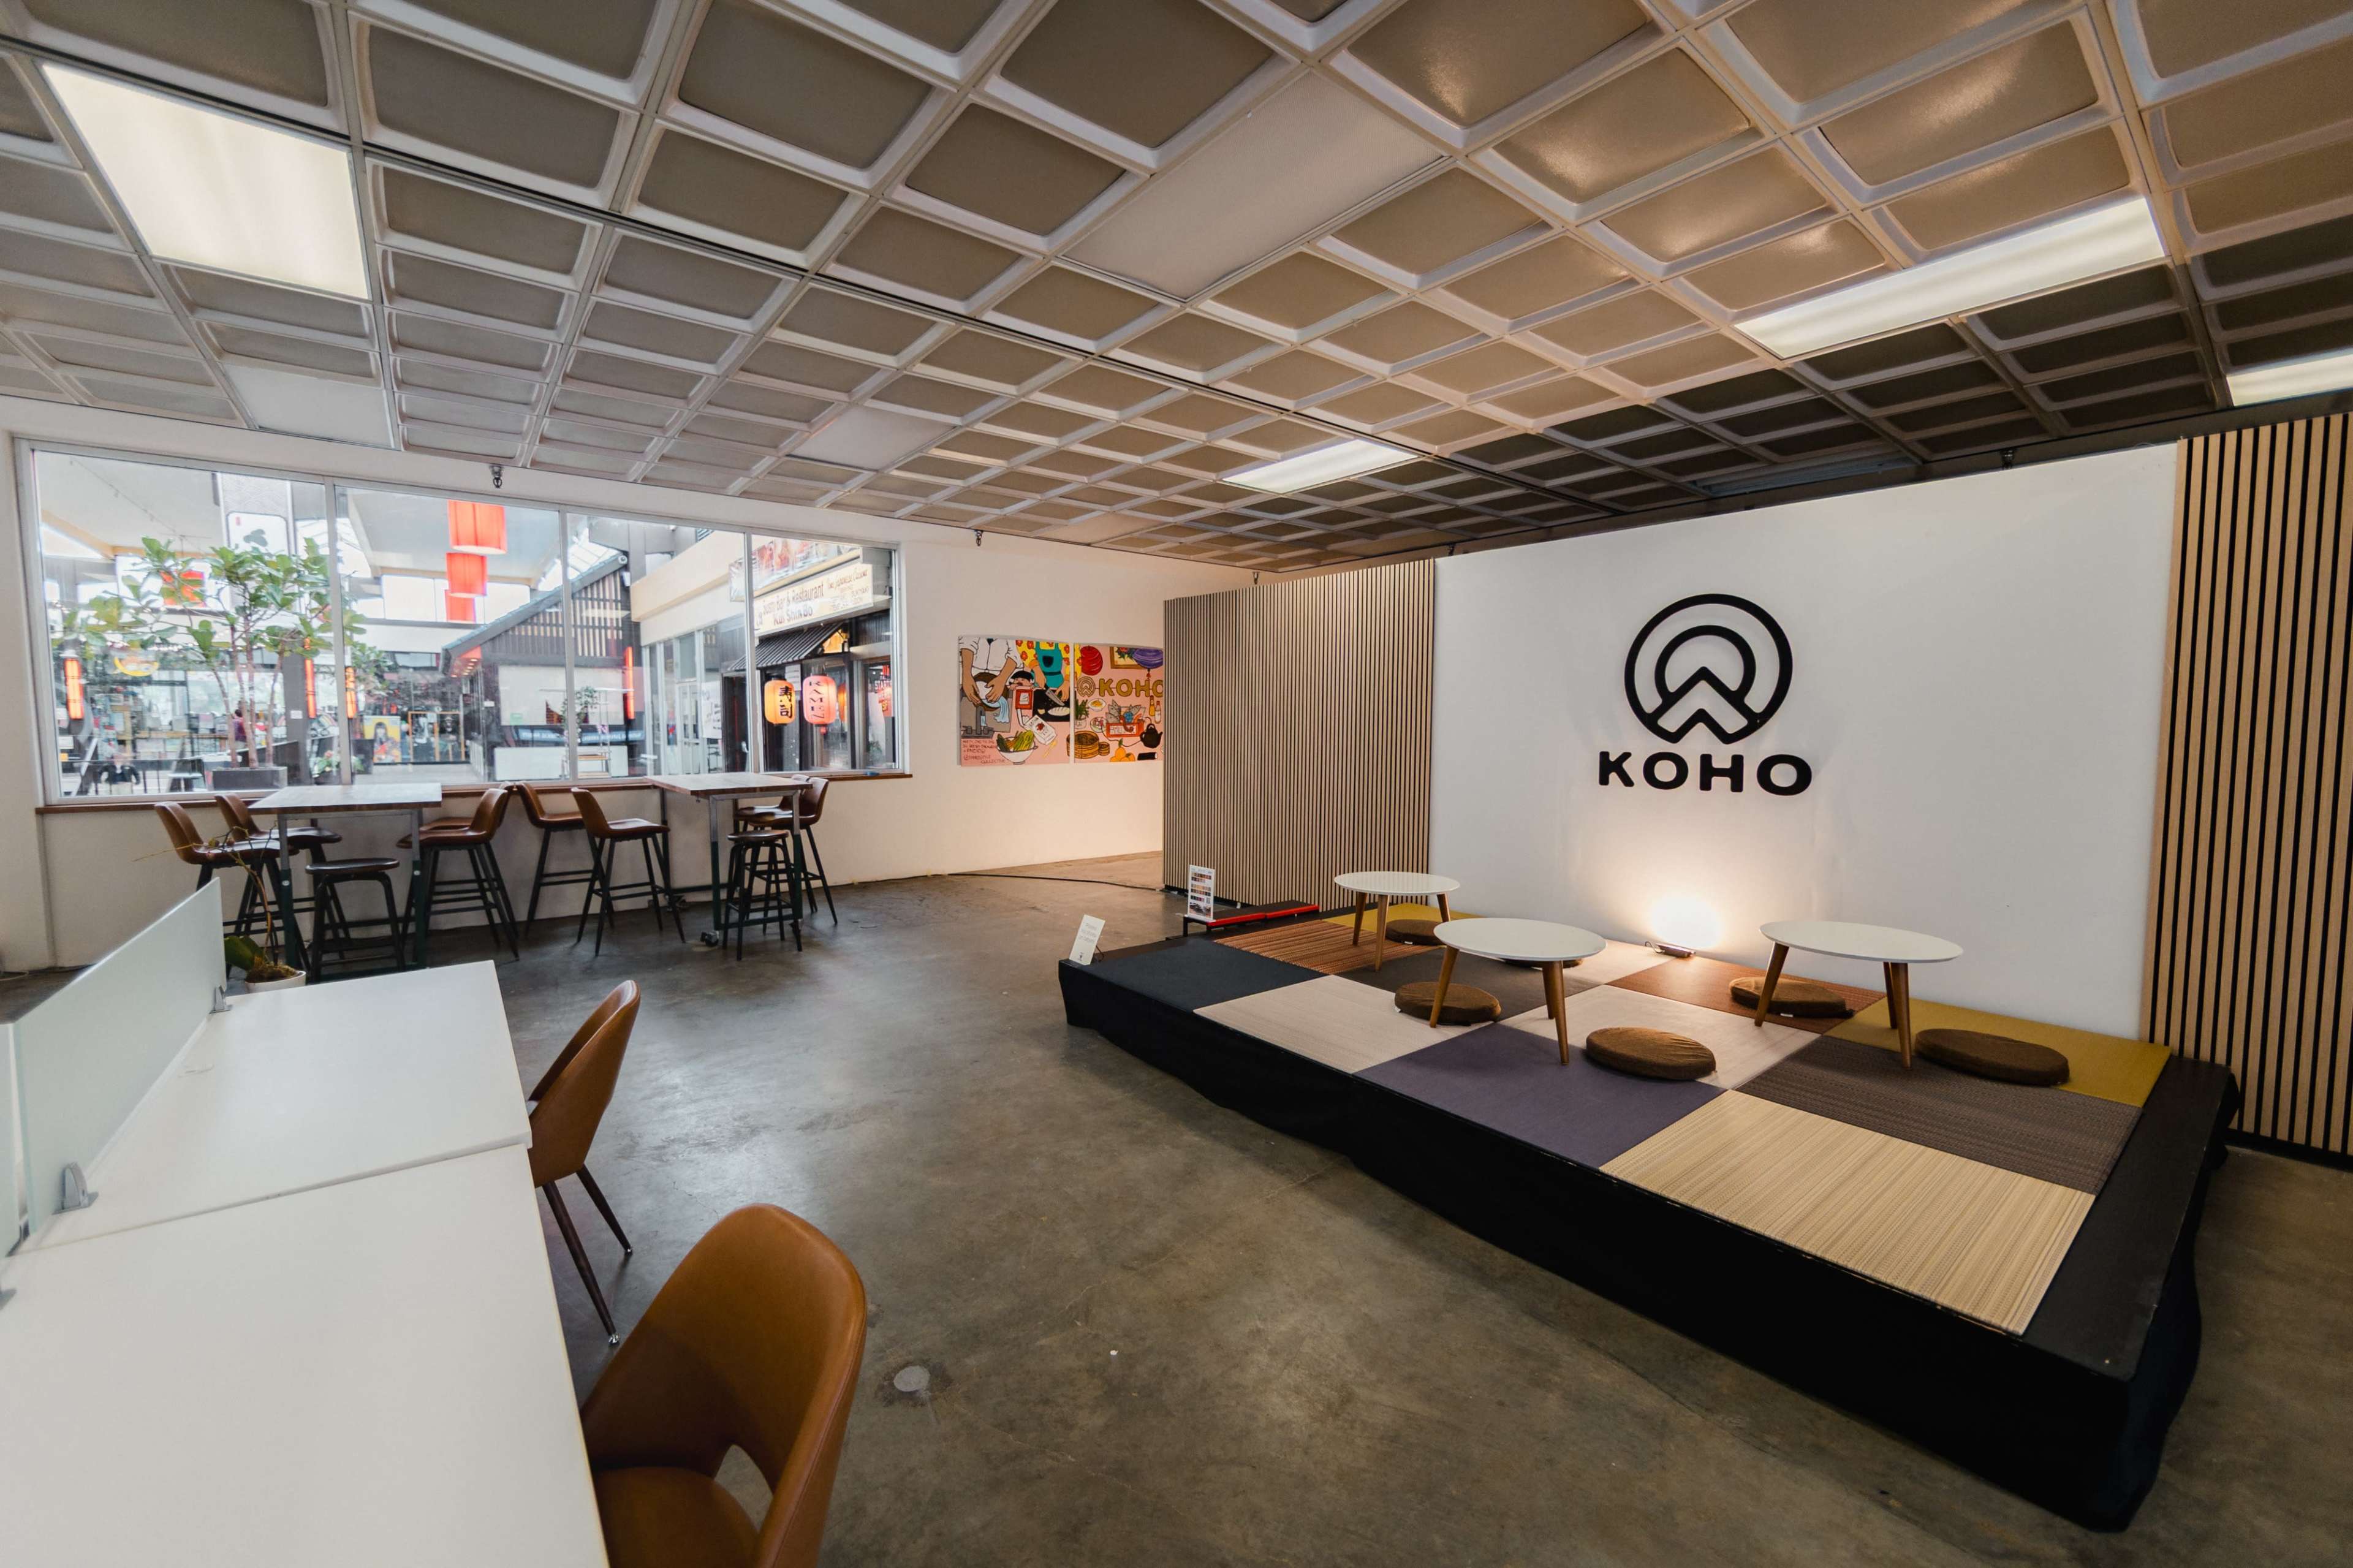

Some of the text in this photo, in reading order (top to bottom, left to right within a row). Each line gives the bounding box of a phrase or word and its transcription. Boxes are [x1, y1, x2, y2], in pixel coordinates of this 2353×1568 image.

[776, 595, 786, 612] Bar
[792, 583, 824, 604] Restaurant
[1099, 678, 1163, 697] KOHO
[1599, 751, 1812, 796] KOHO
